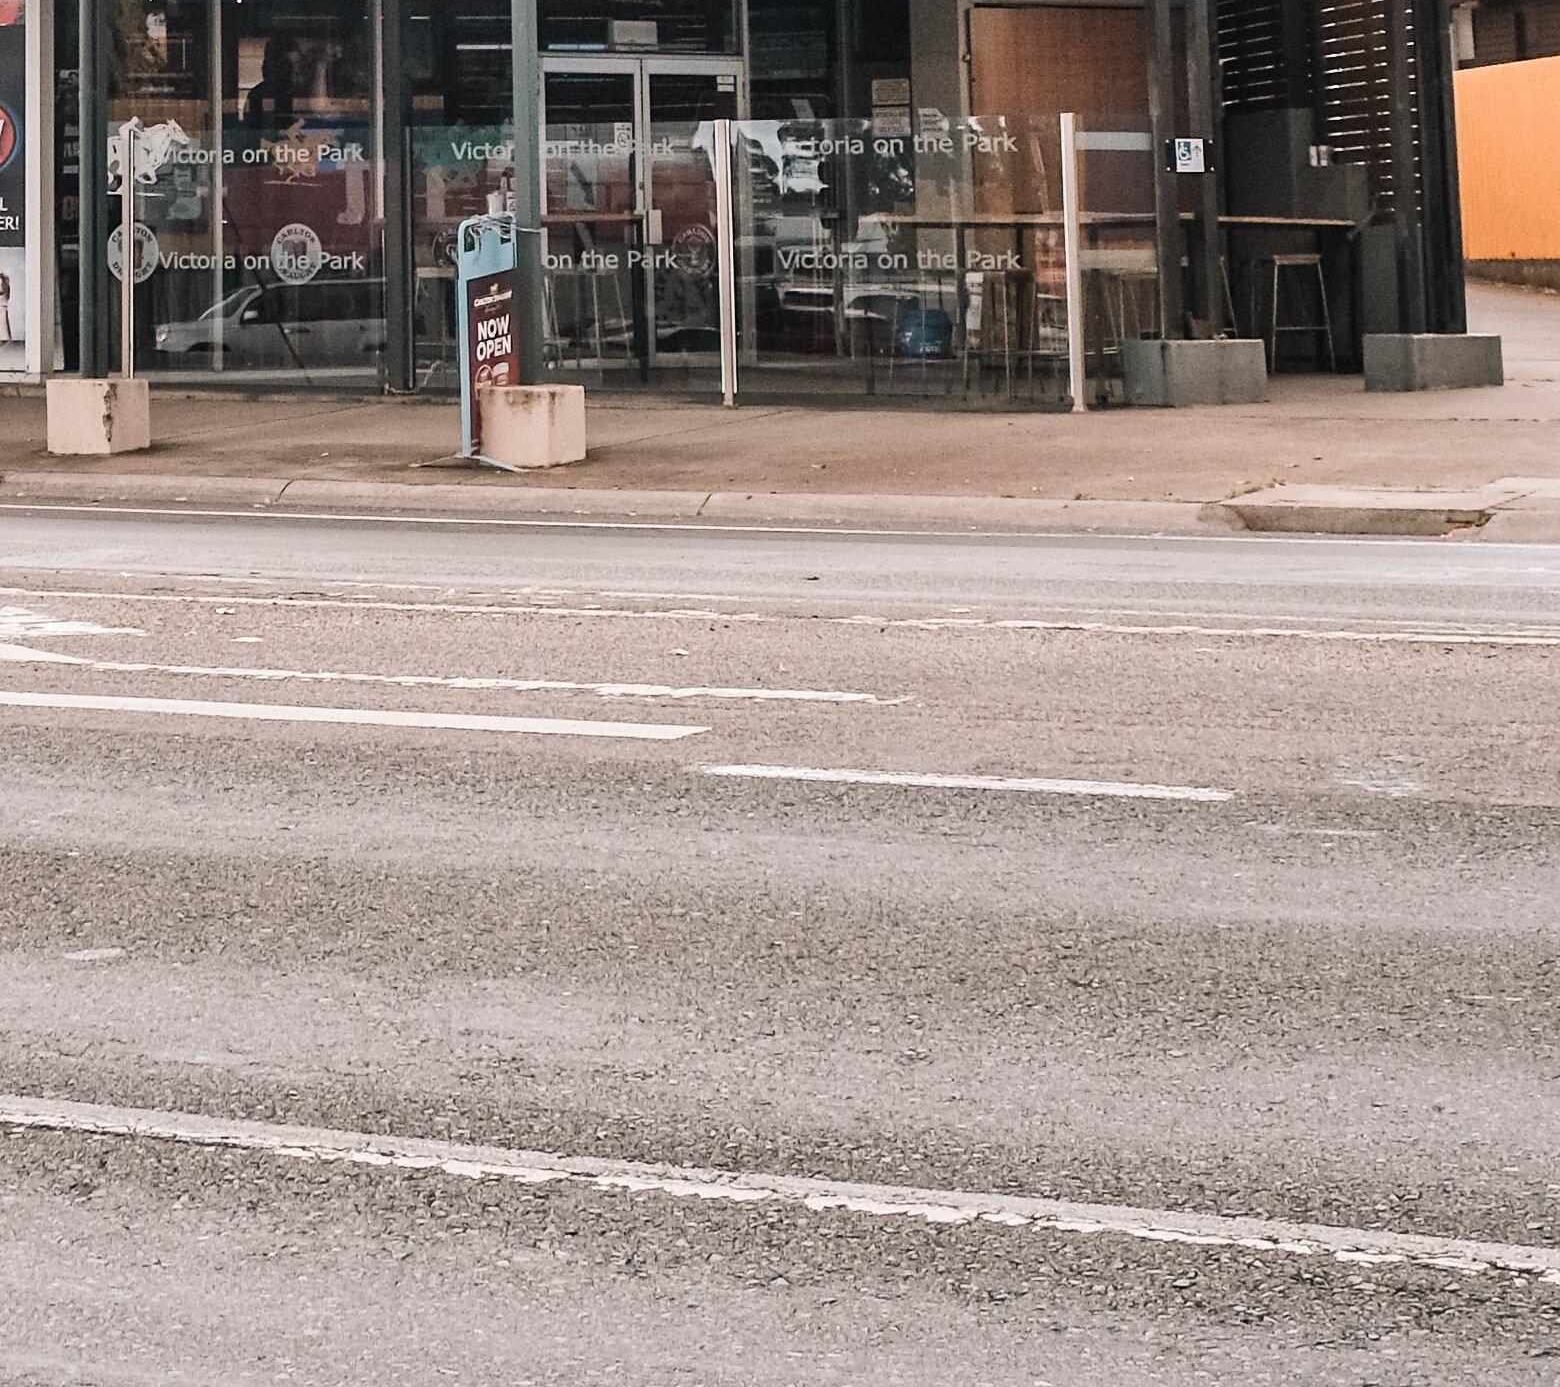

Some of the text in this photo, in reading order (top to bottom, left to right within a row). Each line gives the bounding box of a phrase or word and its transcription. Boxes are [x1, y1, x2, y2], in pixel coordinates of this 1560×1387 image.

[242, 148, 269, 164] on
[276, 144, 311, 164] the
[316, 144, 366, 165] Park
[451, 141, 514, 161] Victor
[873, 137, 904, 155] on
[913, 134, 954, 155] the
[963, 133, 1019, 155] Park
[244, 253, 270, 270] on
[318, 250, 366, 271] Park
[543, 251, 573, 270] on
[580, 249, 619, 270] the
[626, 249, 679, 271] Park
[877, 252, 908, 270] on
[916, 249, 957, 270] the
[965, 249, 1022, 270] Park
[477, 314, 511, 342] NOW
[476, 333, 512, 362] OPEN
